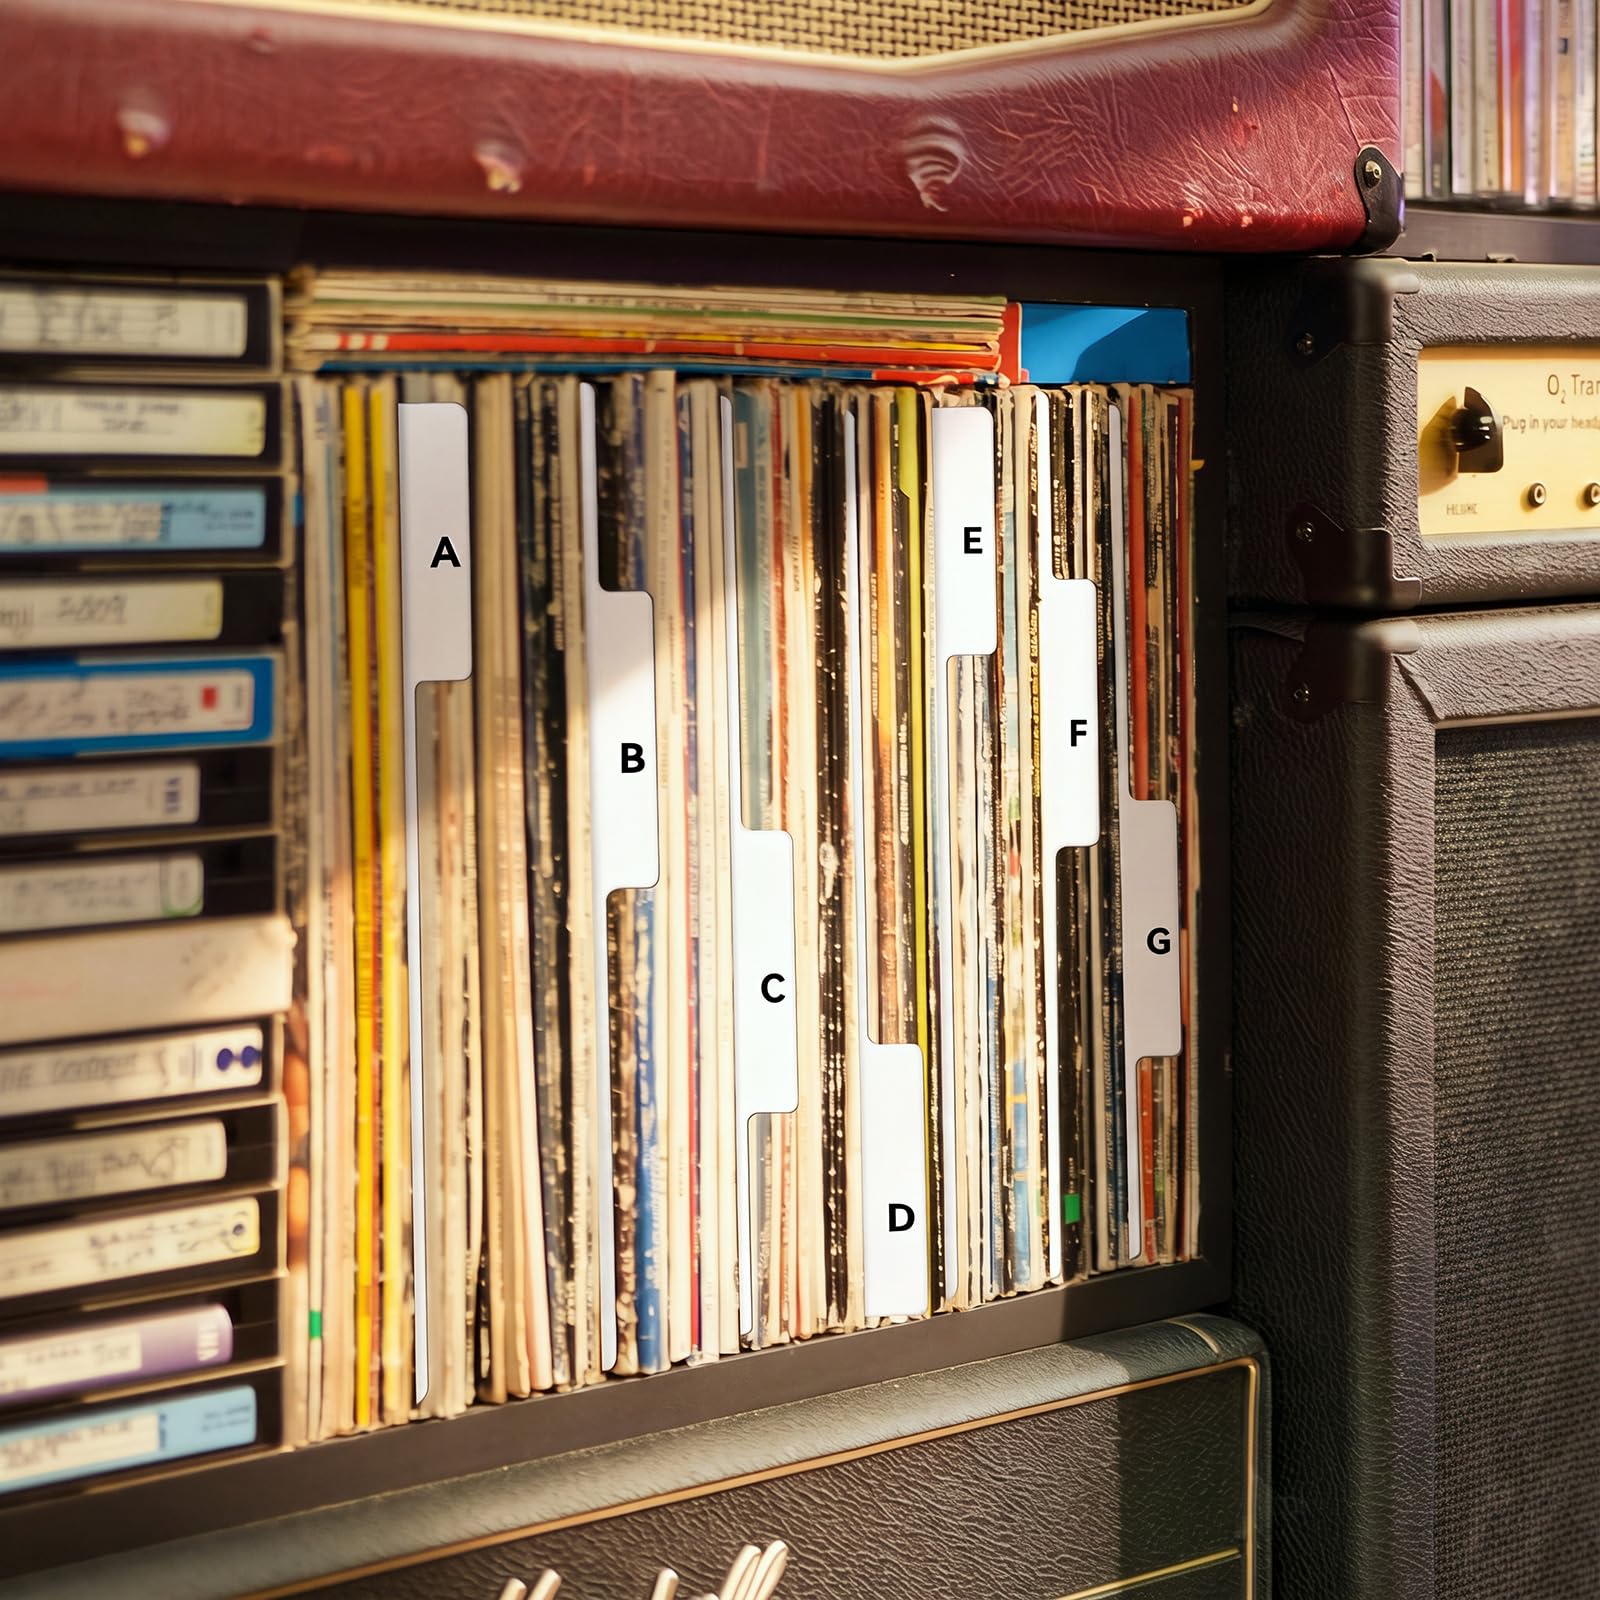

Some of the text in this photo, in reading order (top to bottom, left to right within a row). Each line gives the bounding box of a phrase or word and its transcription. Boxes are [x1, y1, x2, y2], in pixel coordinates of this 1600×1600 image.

[430, 536, 462, 569] A
[963, 526, 983, 554] E
[1070, 719, 1088, 747] F
[621, 742, 646, 774] B
[1146, 927, 1171, 955] G
[760, 973, 786, 1004] C
[888, 1203, 915, 1233] D
